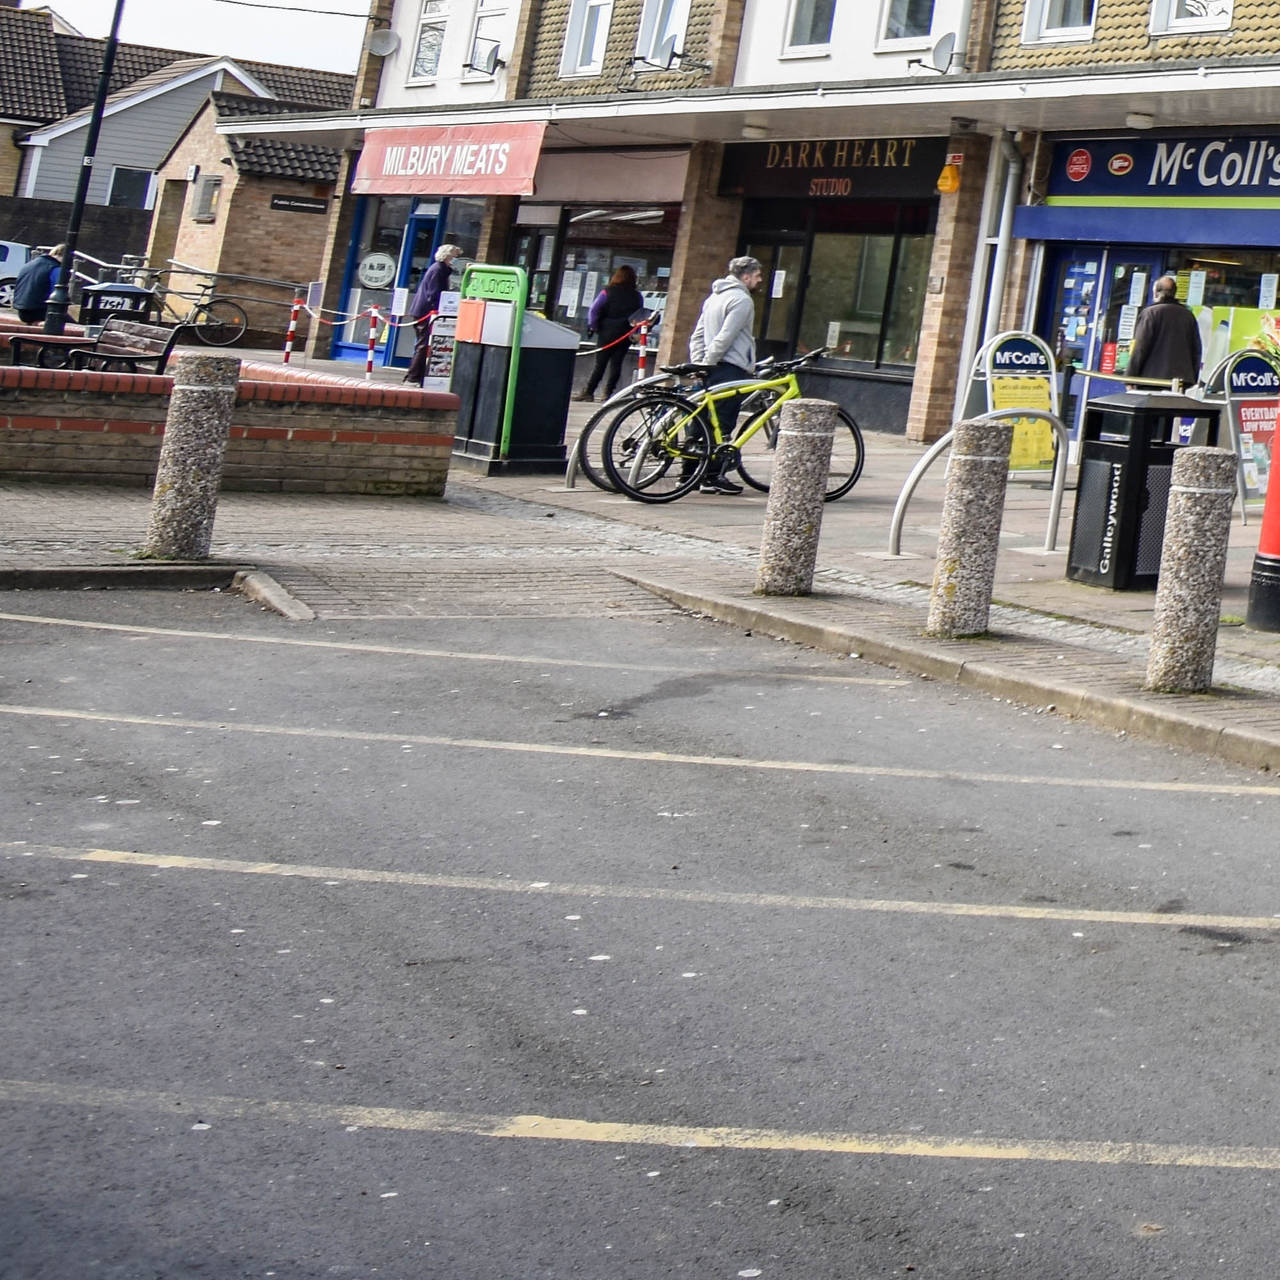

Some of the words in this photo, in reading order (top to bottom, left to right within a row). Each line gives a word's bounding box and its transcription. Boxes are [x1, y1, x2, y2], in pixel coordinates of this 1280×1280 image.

[382, 146, 452, 177] MILBURY
[450, 143, 511, 176] MEATS
[766, 141, 827, 169] DARK
[832, 139, 916, 167] HEART
[808, 178, 852, 196] STUDIO
[995, 350, 1046, 366] McColl's
[1232, 372, 1280, 388] McColl's
[1100, 463, 1122, 574] Galleywood
